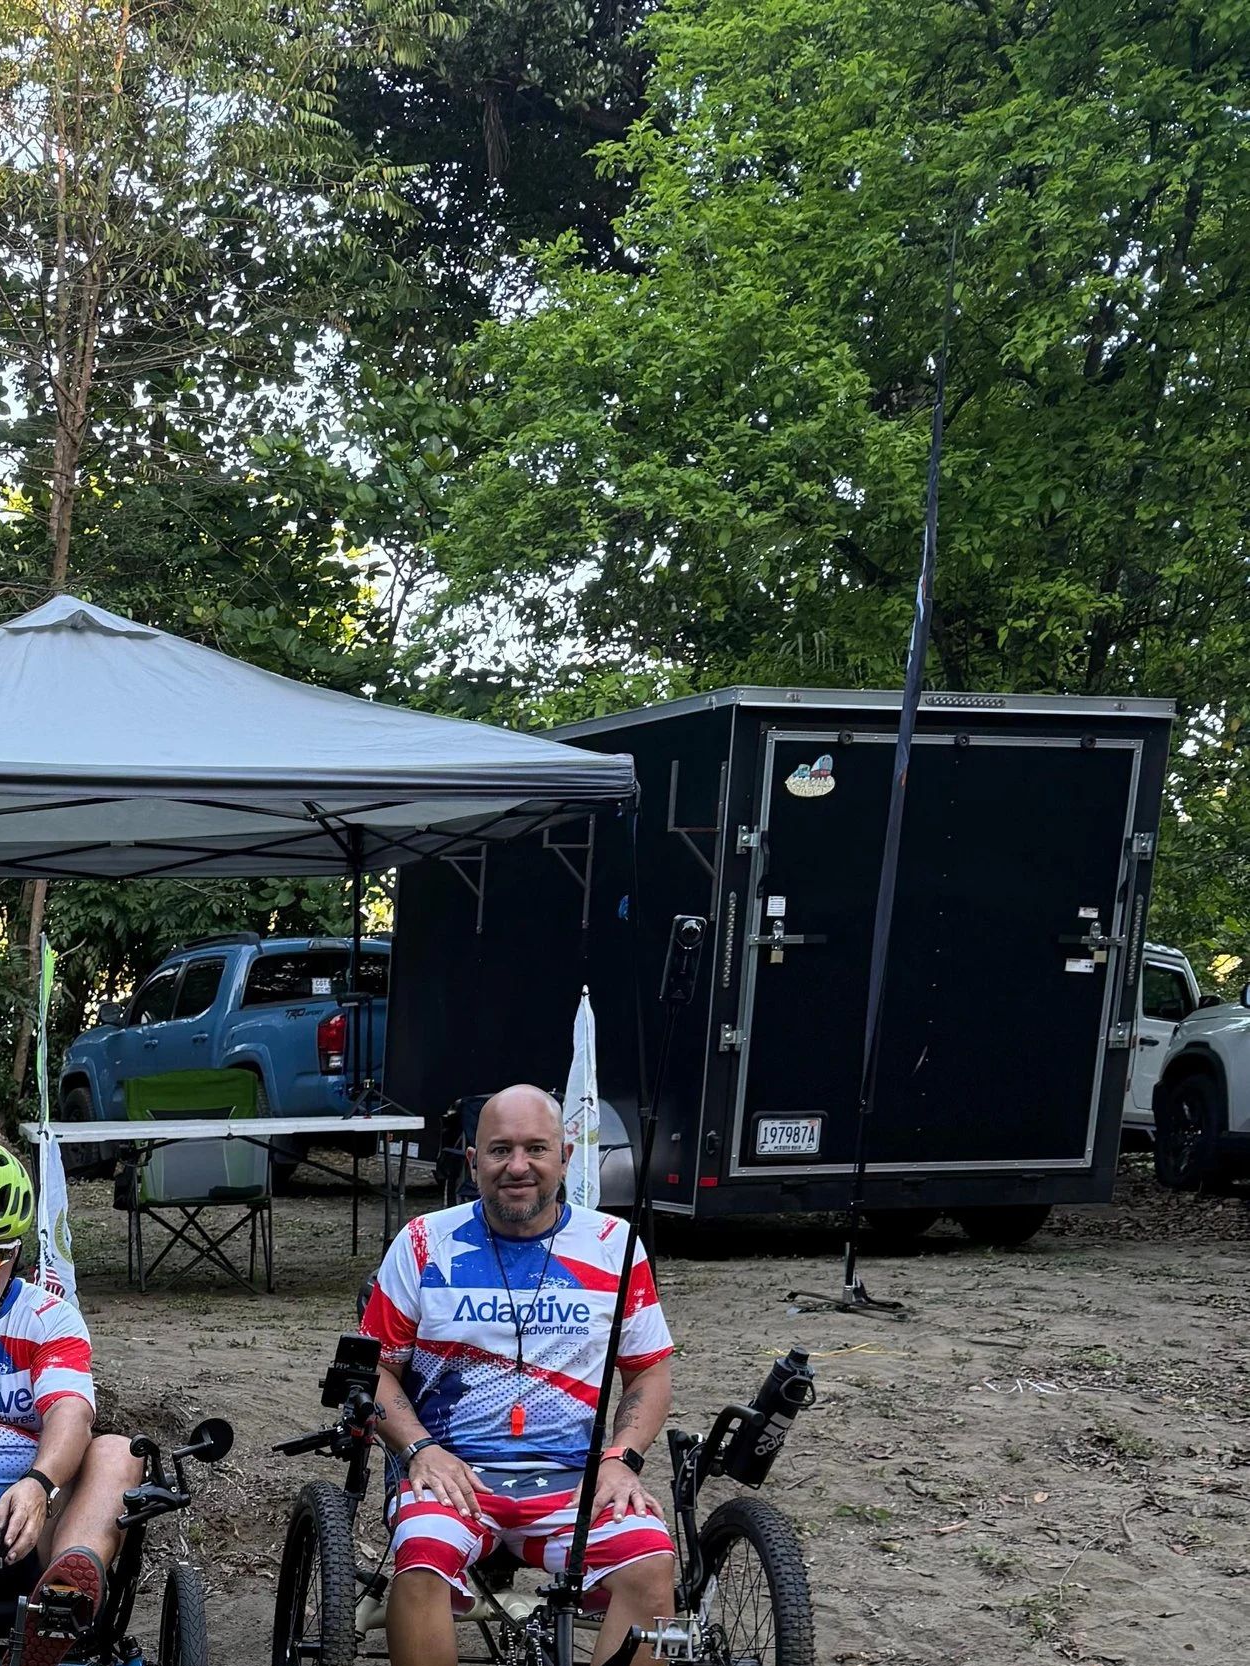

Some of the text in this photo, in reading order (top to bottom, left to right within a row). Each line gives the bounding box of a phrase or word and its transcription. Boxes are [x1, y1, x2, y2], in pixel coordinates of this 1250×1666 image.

[760, 1125, 815, 1145] 197987A
[452, 1295, 591, 1331] Adaptive
[522, 1324, 589, 1336] adventures
